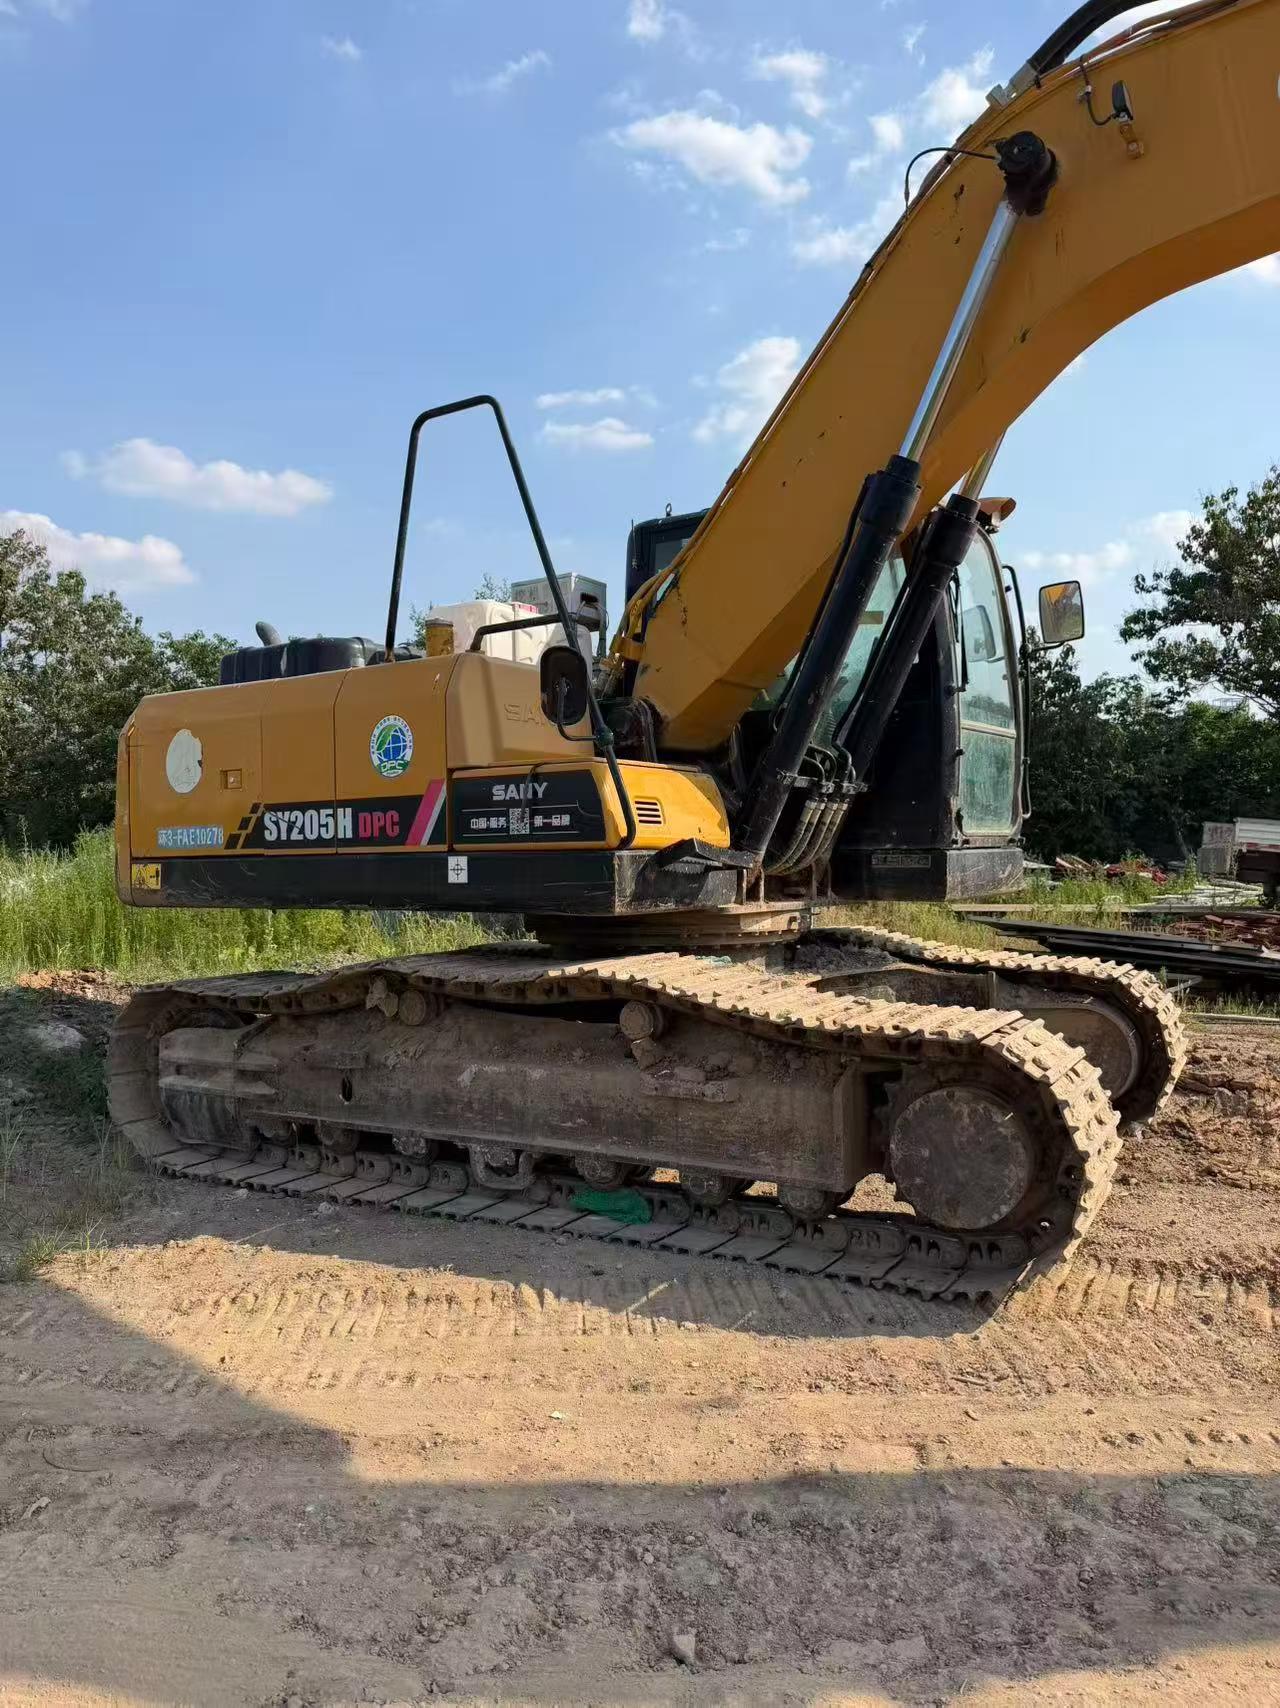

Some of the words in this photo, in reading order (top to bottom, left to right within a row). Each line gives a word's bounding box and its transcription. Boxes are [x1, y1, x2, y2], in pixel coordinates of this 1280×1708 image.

[380, 760, 404, 772] DPC
[492, 782, 548, 801] SANY
[264, 808, 353, 841] SY205H
[358, 810, 400, 839] DPC
